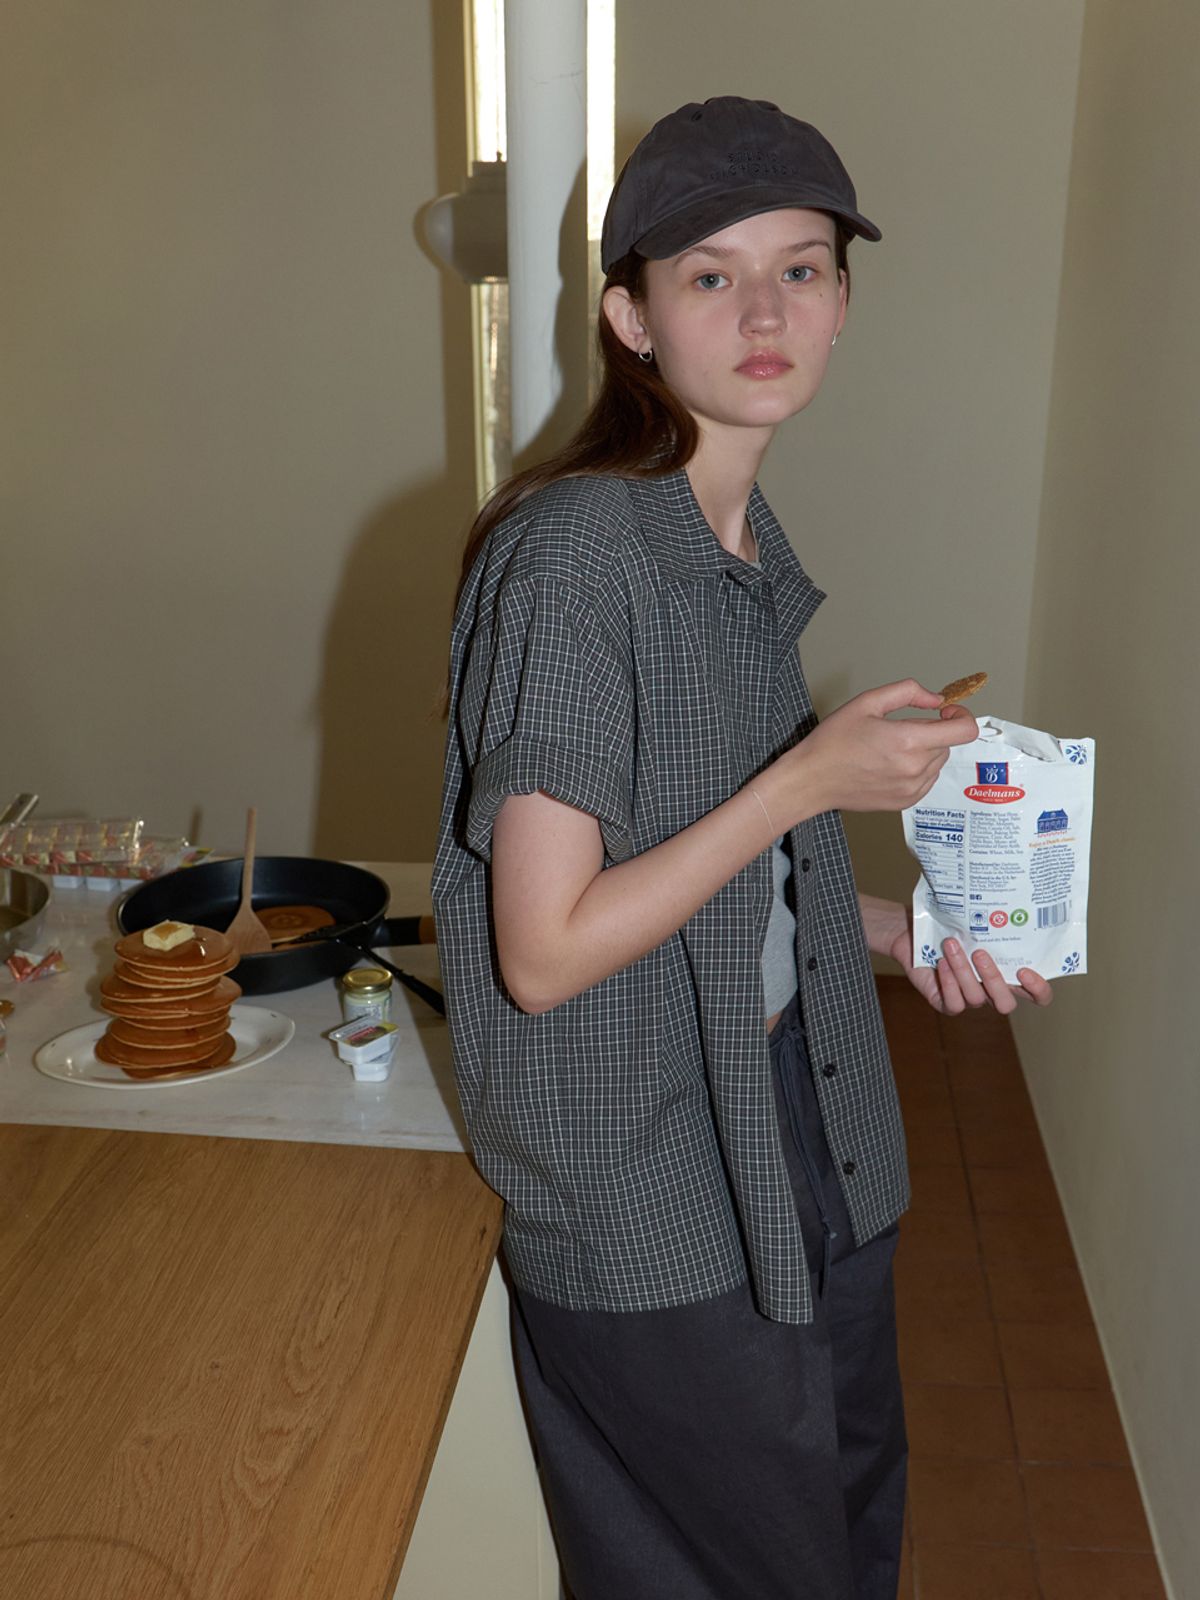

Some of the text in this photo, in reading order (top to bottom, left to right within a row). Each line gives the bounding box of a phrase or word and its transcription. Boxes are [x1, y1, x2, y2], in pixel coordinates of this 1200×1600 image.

[968, 788, 1021, 798] Daelmans
[915, 809, 965, 819] Nutrition Facts
[915, 832, 963, 843] Calories 140
